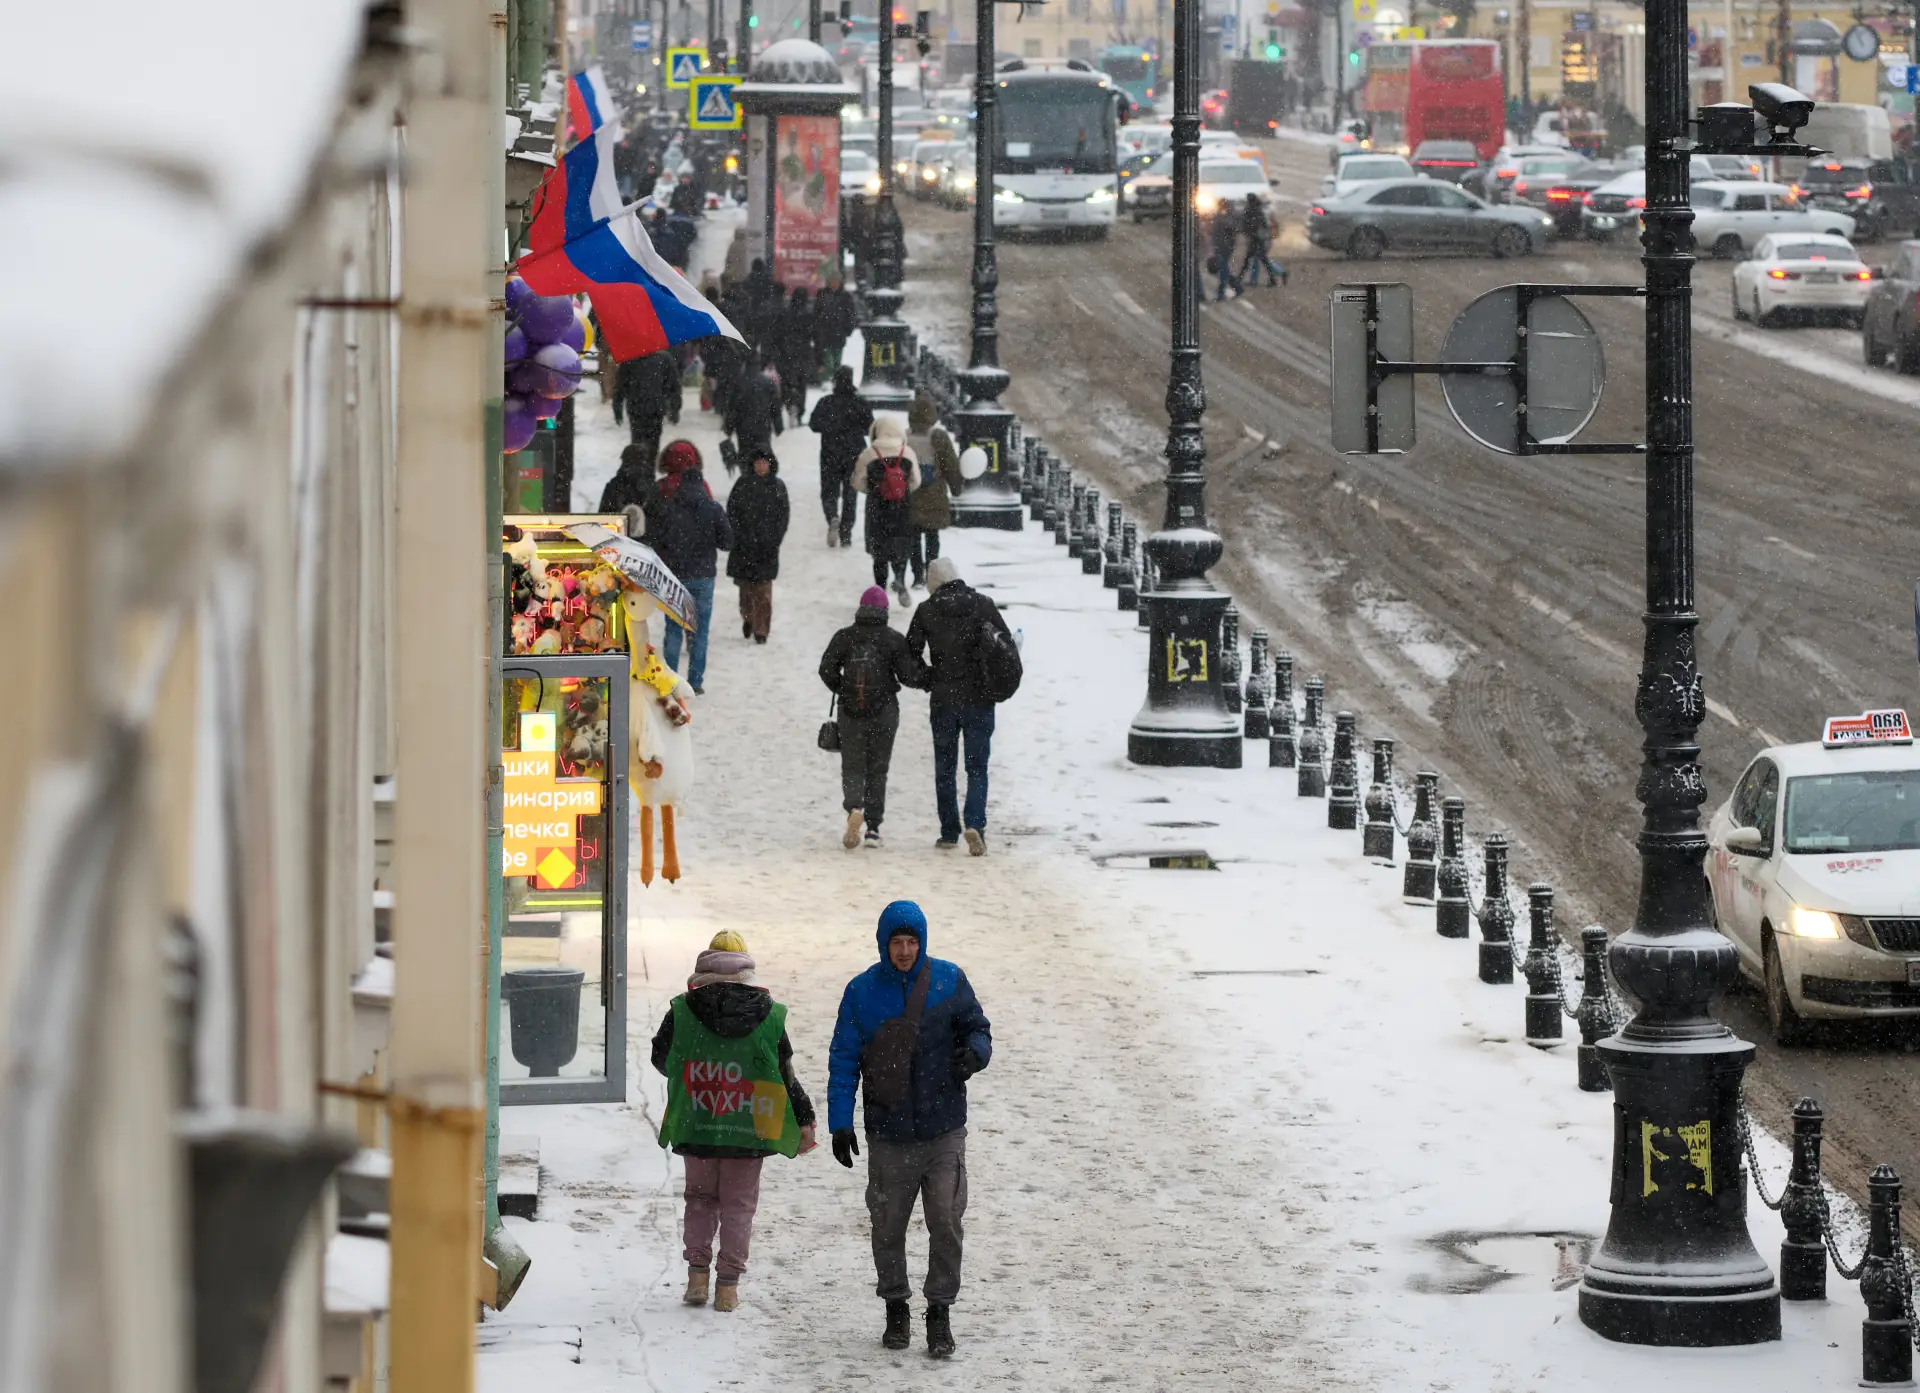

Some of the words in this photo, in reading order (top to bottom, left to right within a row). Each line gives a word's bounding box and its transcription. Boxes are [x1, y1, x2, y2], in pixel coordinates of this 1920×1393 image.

[689, 1061, 743, 1083] КИО
[691, 1090, 774, 1118] КУХНЯ
[1686, 1137, 1707, 1150] АМ
